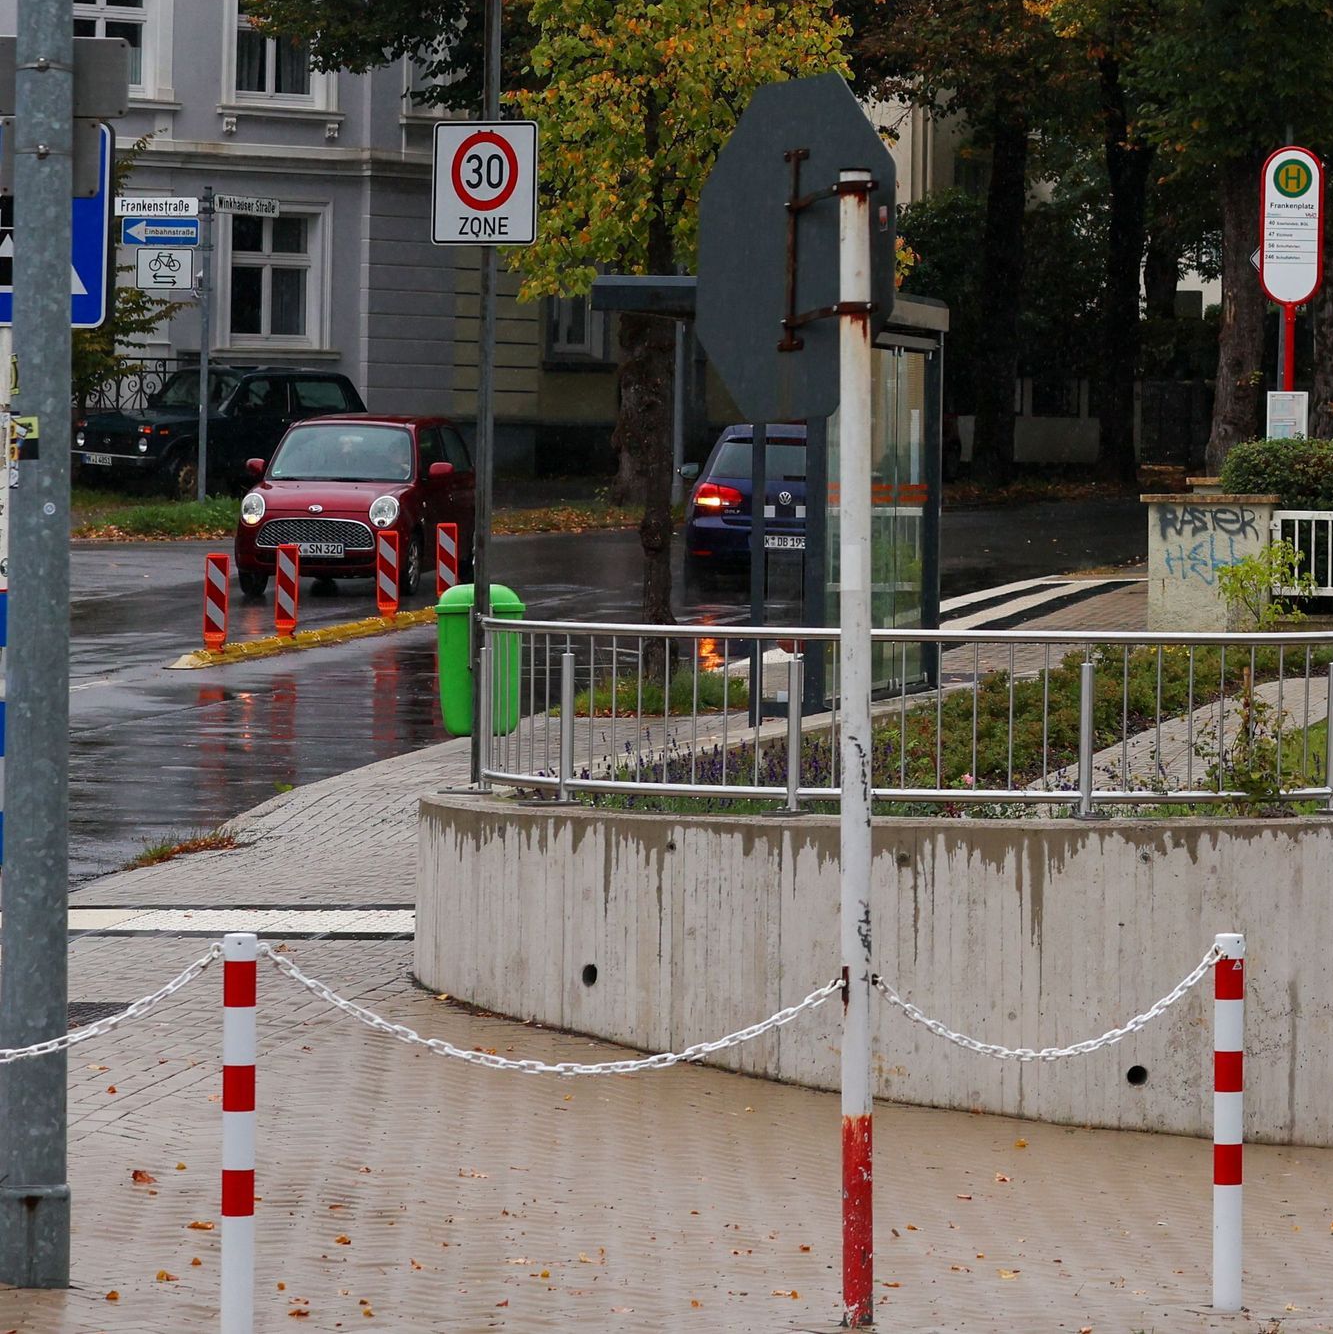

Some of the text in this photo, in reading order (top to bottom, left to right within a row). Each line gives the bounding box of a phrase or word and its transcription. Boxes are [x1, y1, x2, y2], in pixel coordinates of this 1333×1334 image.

[465, 153, 504, 189] 30
[120, 199, 190, 215] Frankenstraße
[254, 200, 276, 214] Straße
[1269, 201, 1315, 211] Frankenplatz
[144, 227, 195, 237] Einbahnstraße
[458, 216, 509, 236] ZONE
[777, 537, 788, 547] DB
[309, 544, 323, 554] SN
[324, 544, 343, 555] 320
